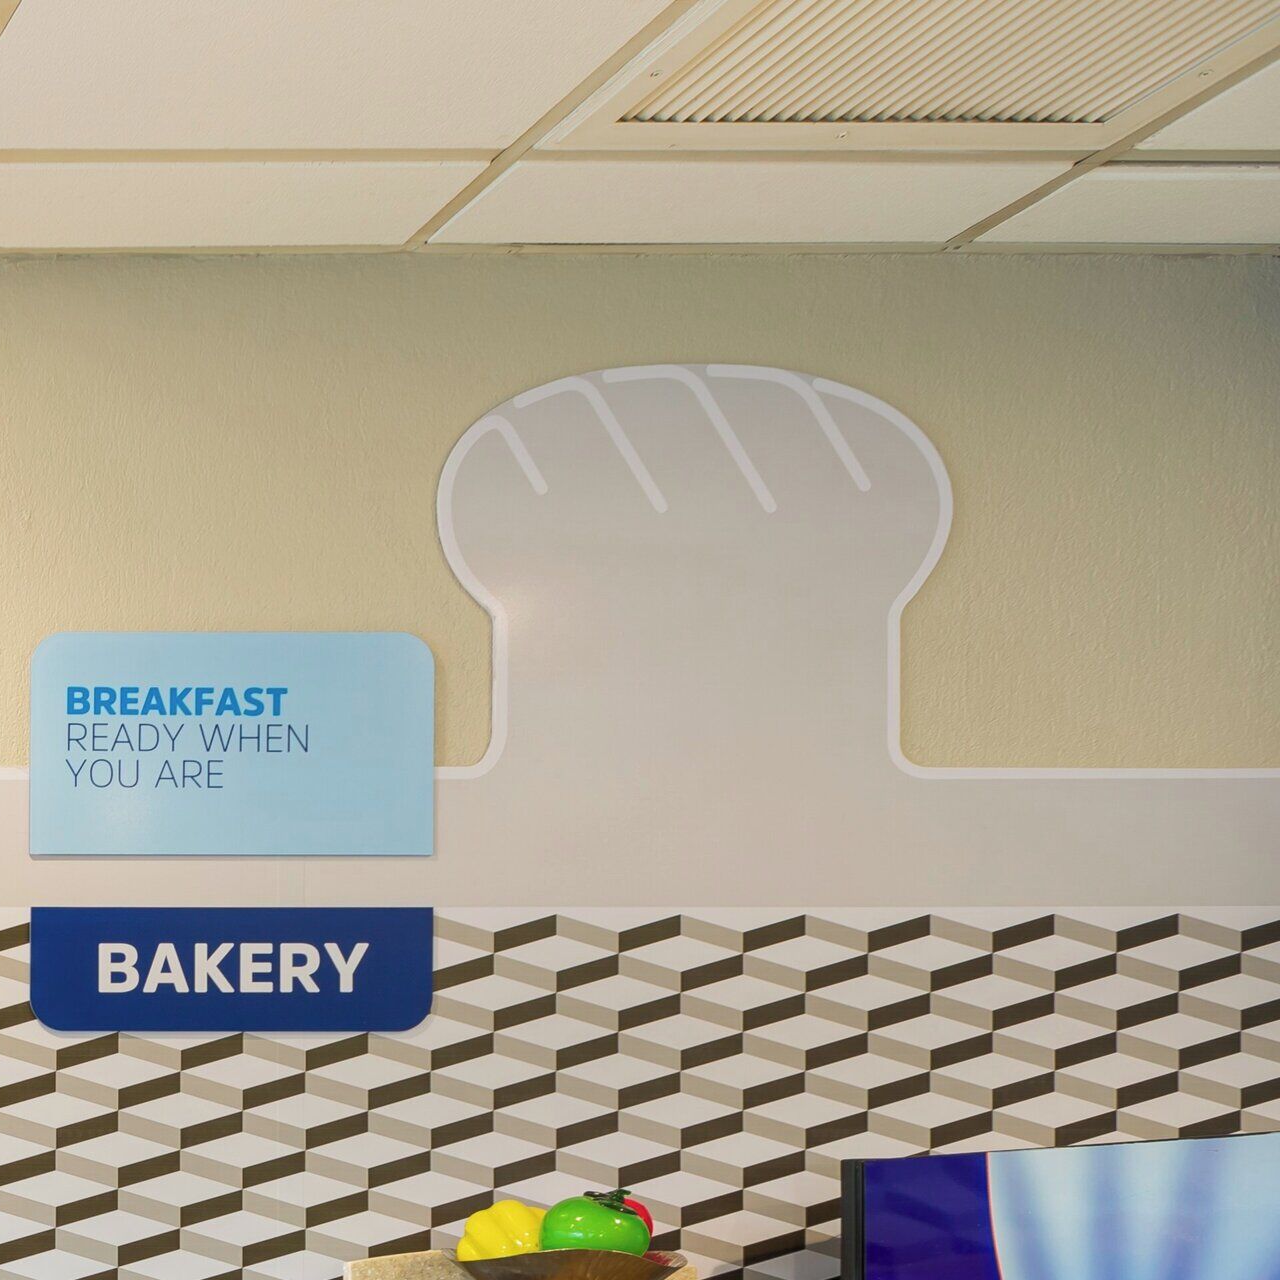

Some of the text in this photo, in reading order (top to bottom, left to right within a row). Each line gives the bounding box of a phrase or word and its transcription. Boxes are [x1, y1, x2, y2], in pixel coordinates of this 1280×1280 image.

[66, 685, 289, 717] BREAKFAST
[66, 722, 310, 753] READY WHEN
[65, 758, 224, 789] YOU ARE
[97, 942, 371, 994] BAKERY
